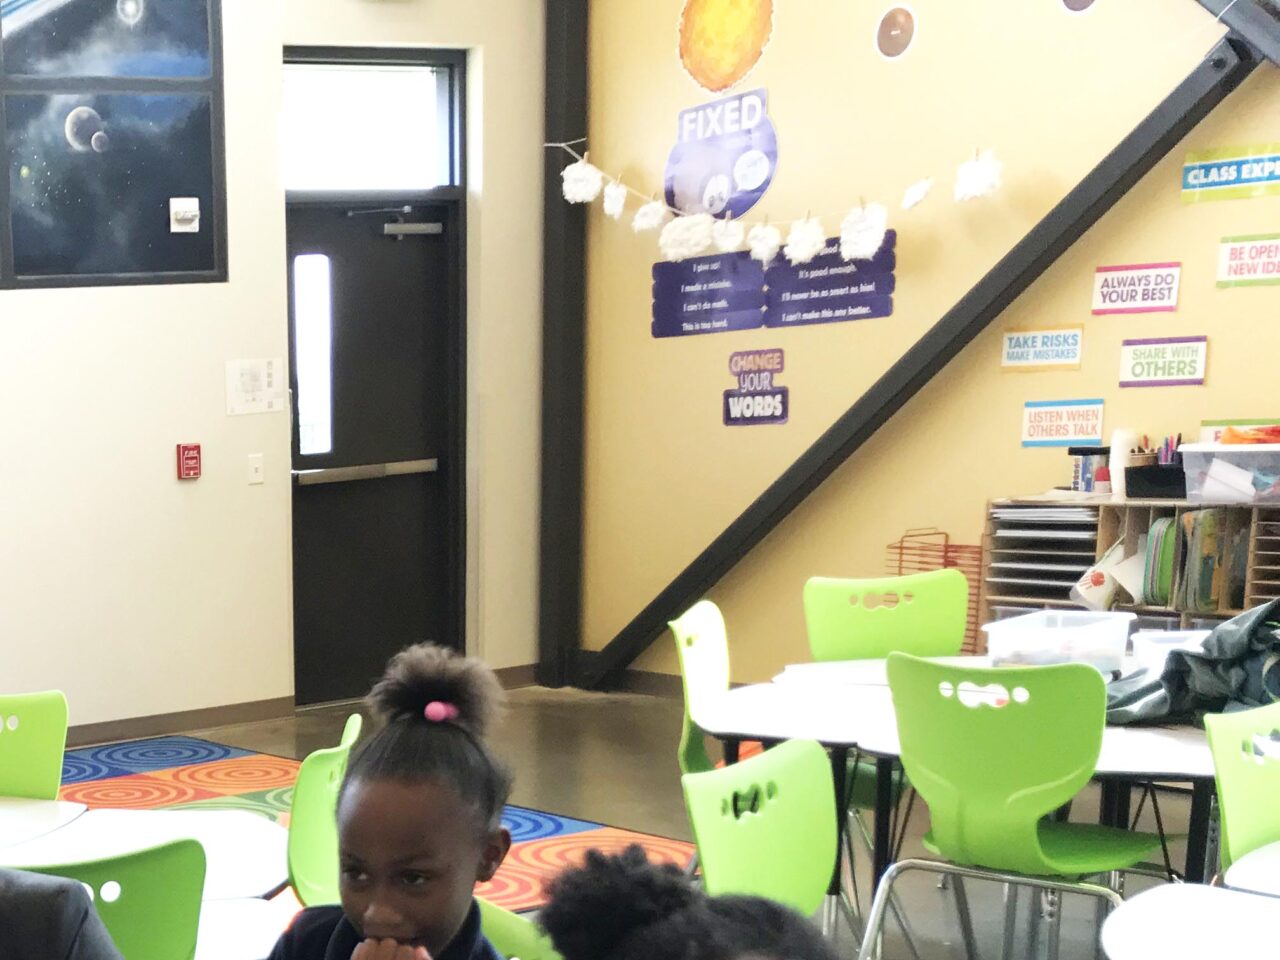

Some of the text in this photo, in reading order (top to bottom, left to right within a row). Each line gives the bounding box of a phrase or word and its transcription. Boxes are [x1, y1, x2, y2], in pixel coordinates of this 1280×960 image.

[681, 95, 762, 142] FIXED
[1187, 165, 1237, 185] CLASS
[1228, 246, 1245, 261] BE
[810, 266, 828, 279] good
[1227, 261, 1259, 276] NEW
[1100, 273, 1175, 289] ALWAYS DO
[1100, 287, 1173, 303] YOUR BEST
[1007, 333, 1079, 349] TAKE RISKS
[1006, 348, 1078, 361] MAKE MISTAKES
[1131, 345, 1199, 360] SHARE WITH
[731, 352, 782, 372] CHANGE
[1131, 359, 1198, 378] OTHERS
[739, 371, 772, 393] YOUR
[728, 394, 783, 418] WORDS
[1028, 408, 1099, 424] LISTEN WHEN
[1027, 423, 1098, 437] OTHERS TALK
